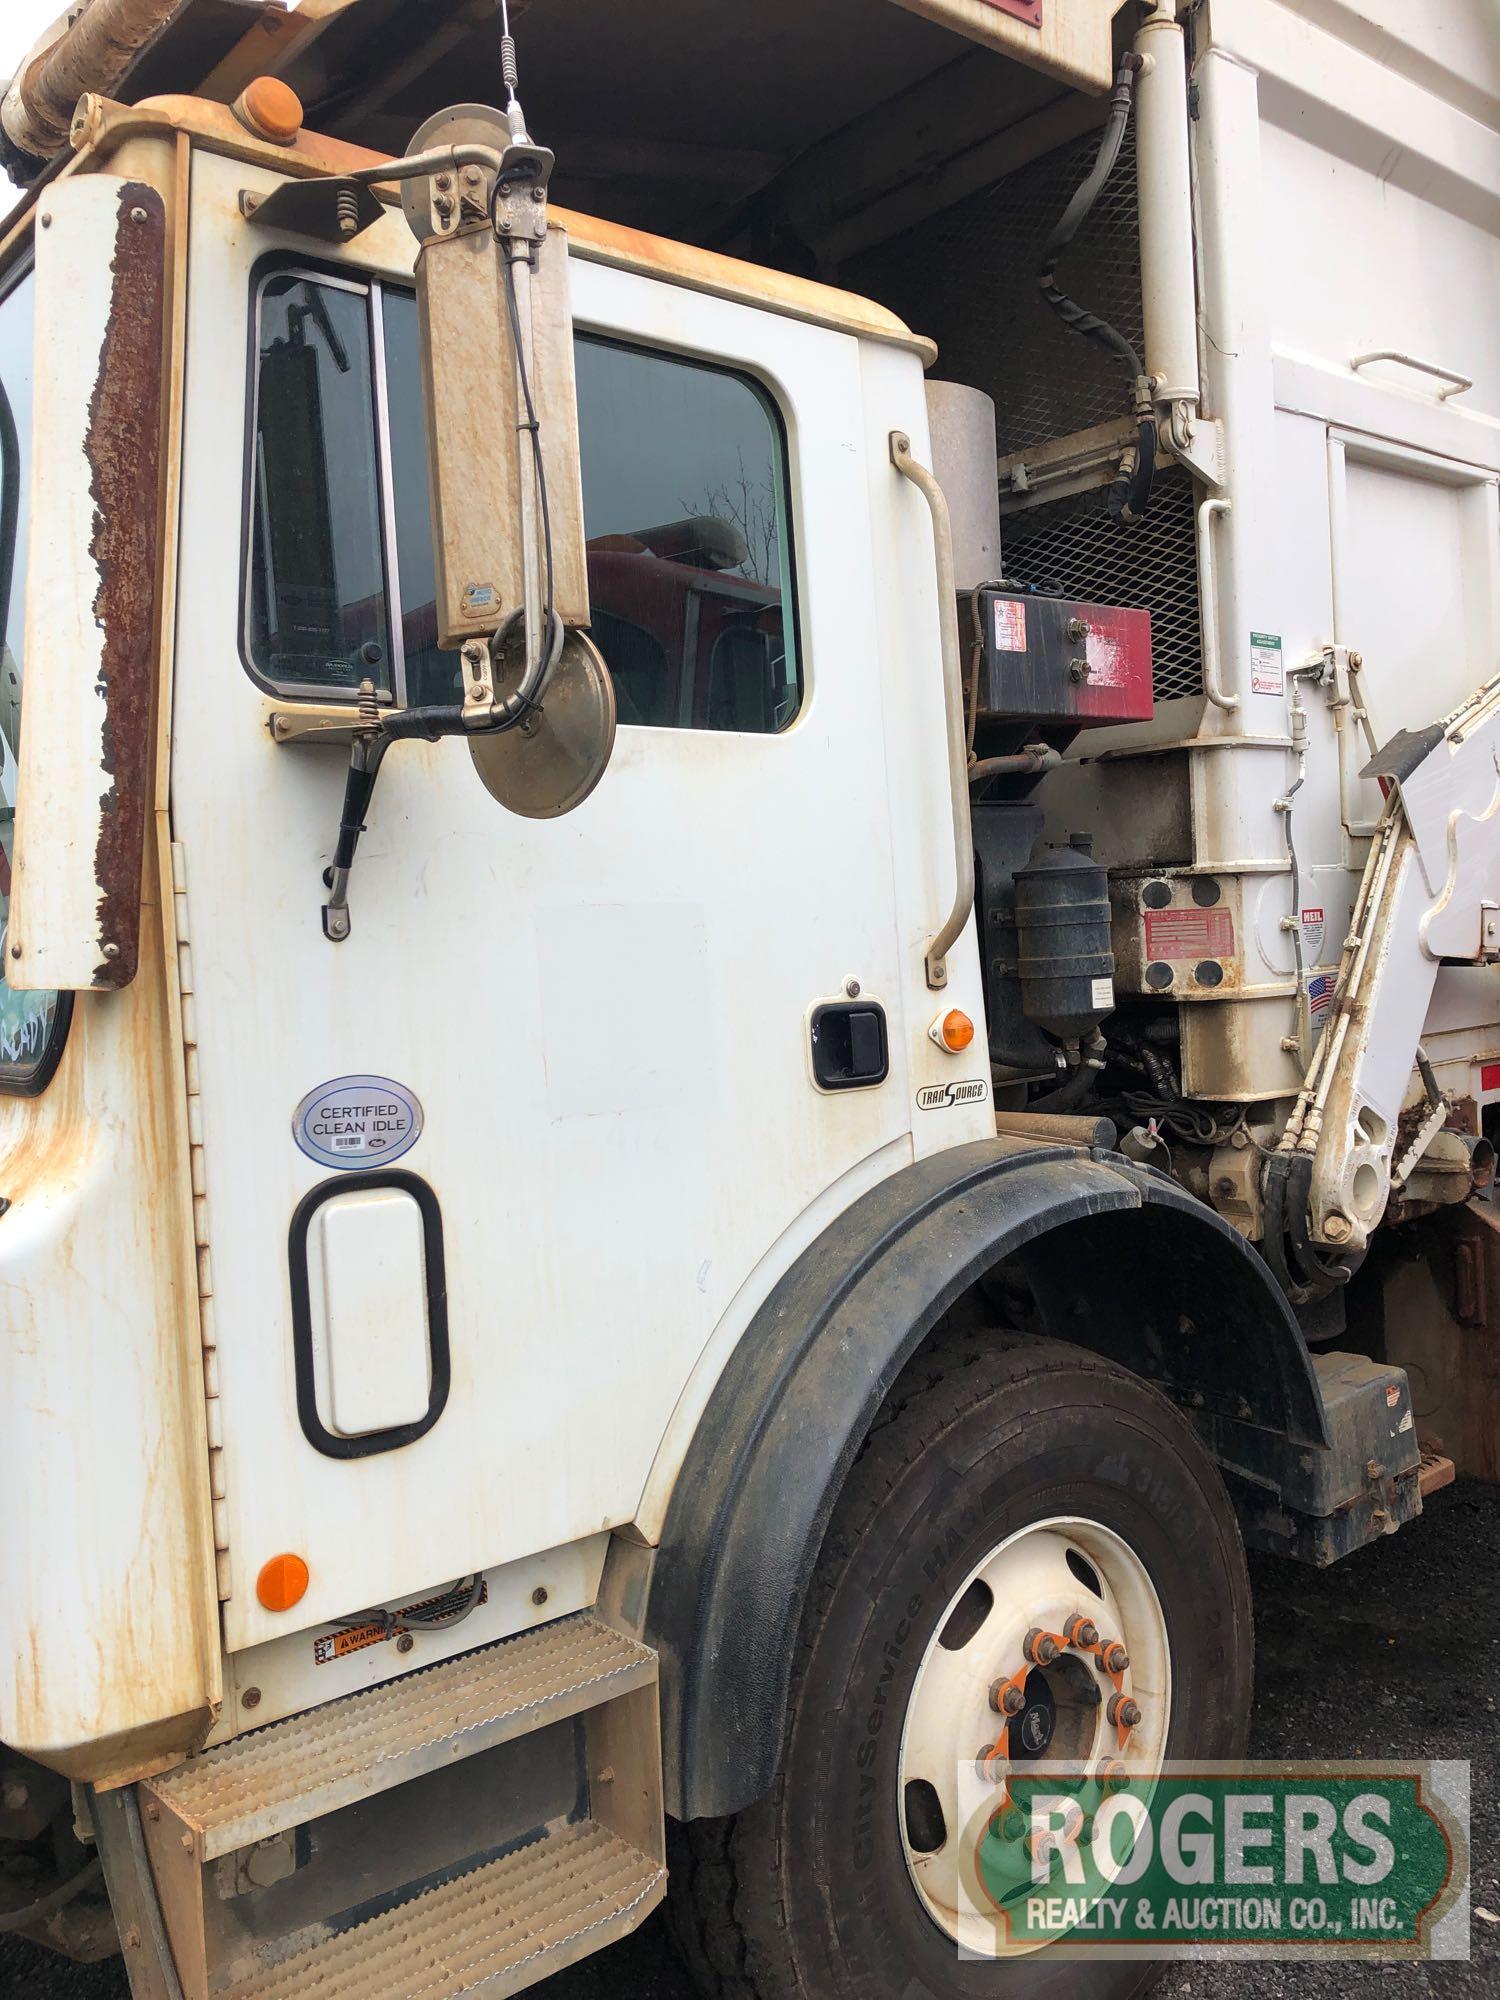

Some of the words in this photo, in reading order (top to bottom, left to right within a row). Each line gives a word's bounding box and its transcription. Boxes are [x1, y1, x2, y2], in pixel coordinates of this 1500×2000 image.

[1303, 911, 1322, 922] HEIL
[320, 1104, 398, 1119] CERTIFIED
[312, 1121, 366, 1135] CLEAN
[372, 1119, 406, 1131] IDLE
[350, 1626, 387, 1645] WARNI
